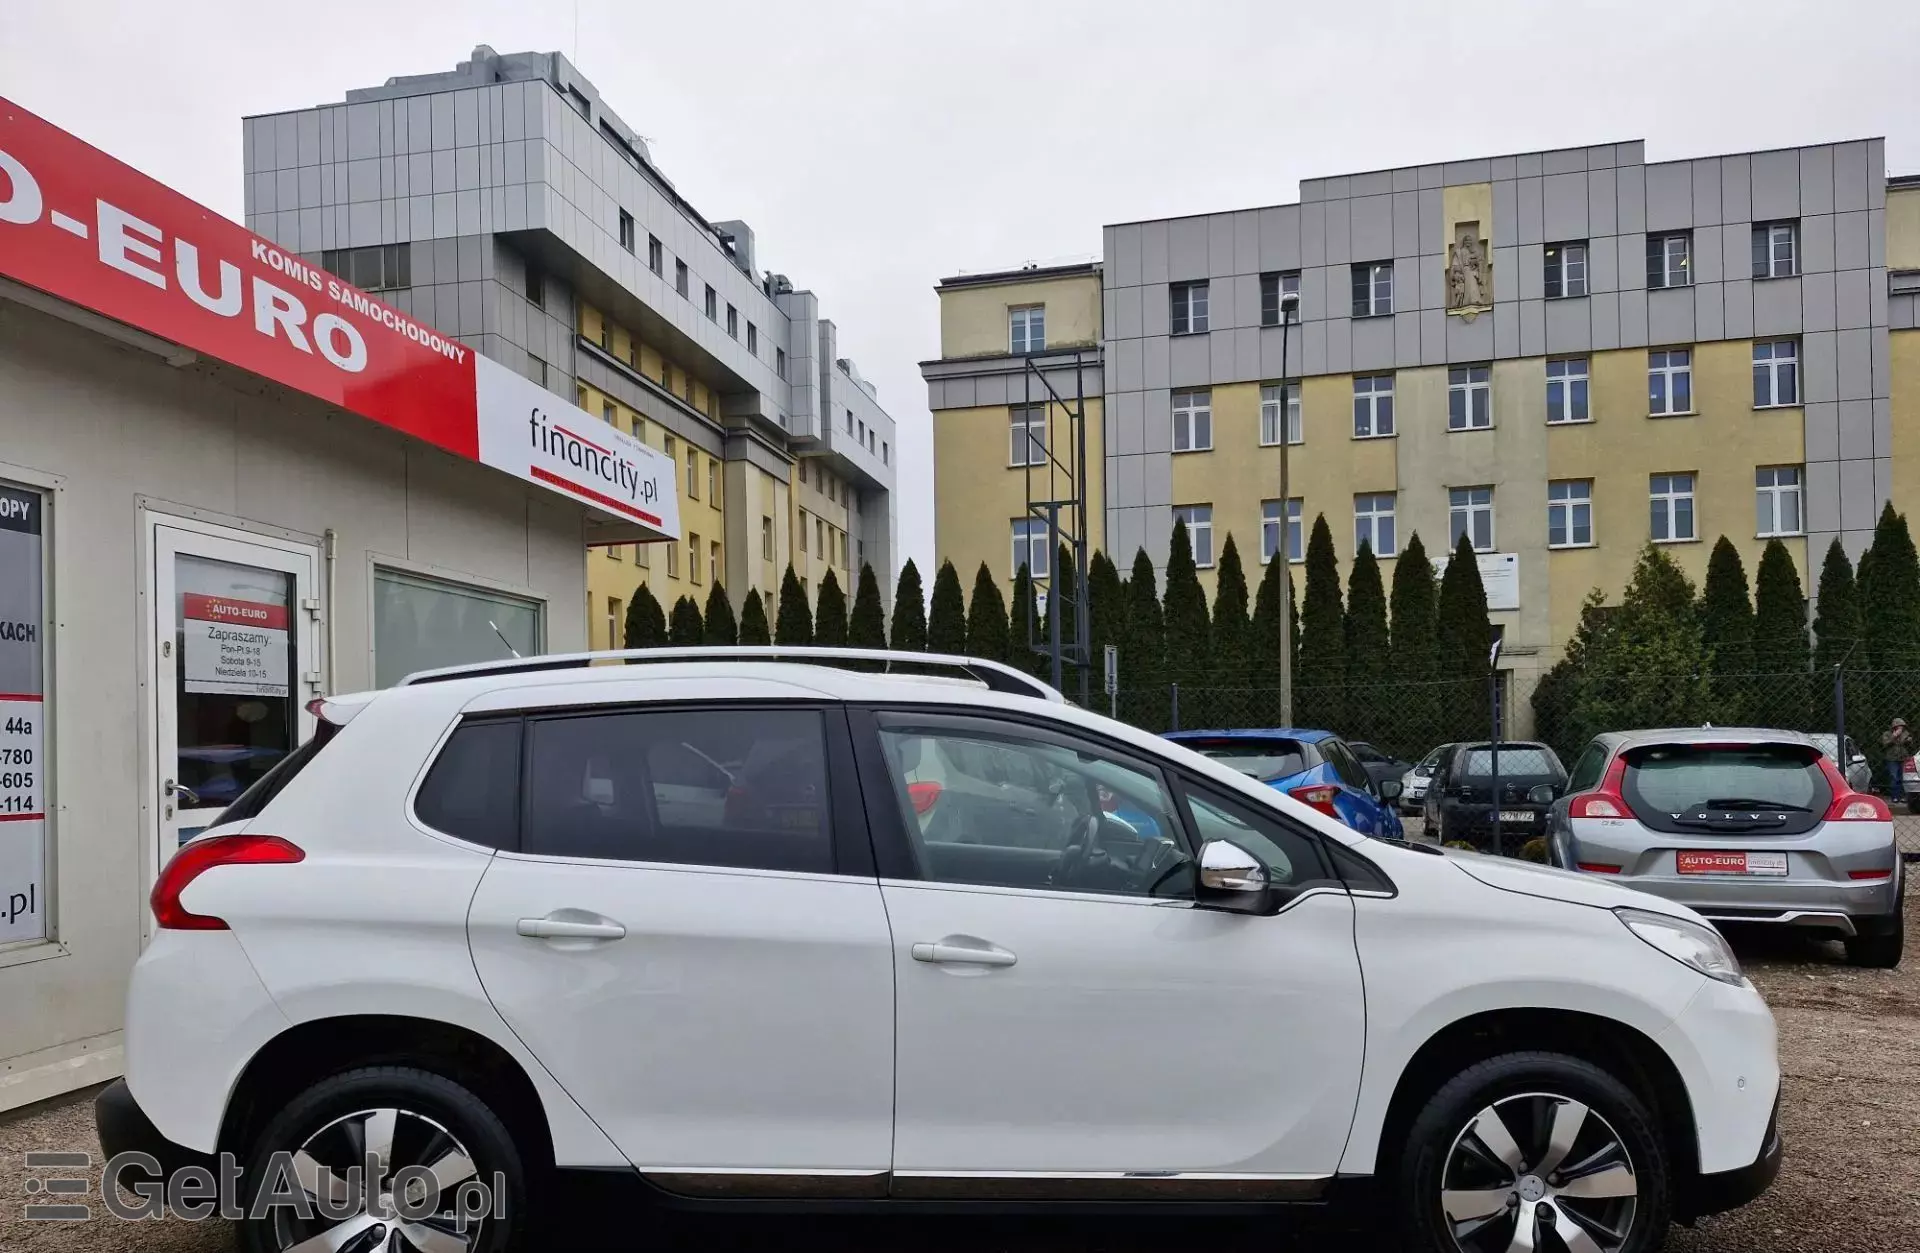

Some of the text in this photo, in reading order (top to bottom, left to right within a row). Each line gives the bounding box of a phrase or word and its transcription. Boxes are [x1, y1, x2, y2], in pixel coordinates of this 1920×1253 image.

[251, 239, 466, 364] KOMIS SAMOCHODOWY
[529, 408, 658, 504] financity.pl
[212, 604, 268, 619] AUTO-EURO
[208, 626, 272, 647] Zapraszamy:
[221, 655, 245, 666] Sobota
[215, 667, 247, 678] Niedziela
[5, 716, 33, 735] 44a
[1684, 857, 1745, 866] AUTO-EURO
